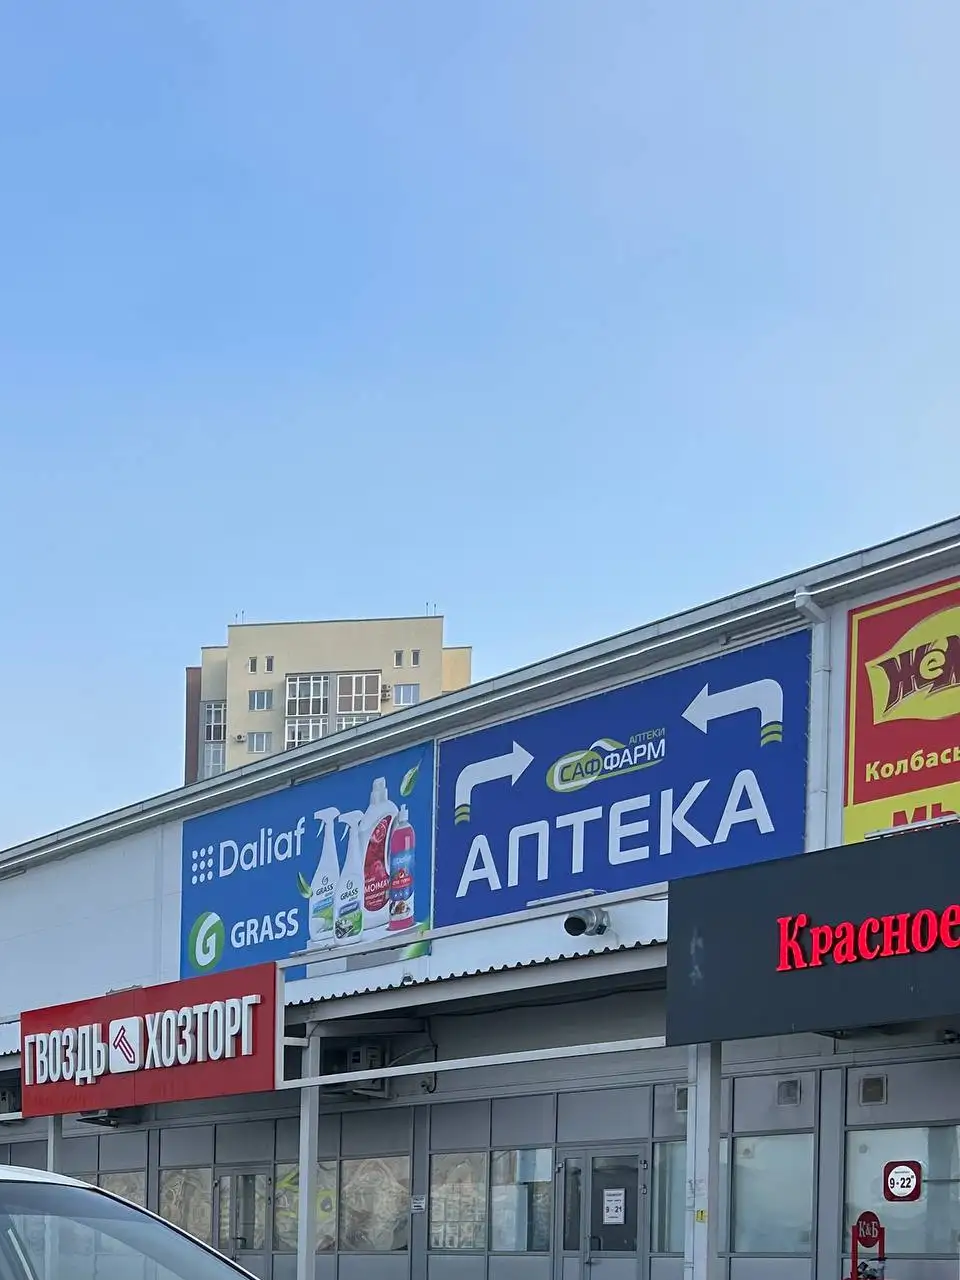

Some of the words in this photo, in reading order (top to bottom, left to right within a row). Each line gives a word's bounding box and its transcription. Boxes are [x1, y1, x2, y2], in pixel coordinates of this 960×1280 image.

[559, 738, 666, 783] САФФАРМ
[629, 727, 666, 745] АПТЕКИ
[218, 816, 306, 878] Daliaf
[455, 769, 775, 898] АПТЕКА
[230, 907, 299, 949] GRASS
[776, 904, 960, 972] Красное
[24, 1023, 109, 1086] ГВОЗДЬ
[144, 994, 261, 1069] ХОЗТОРГ
